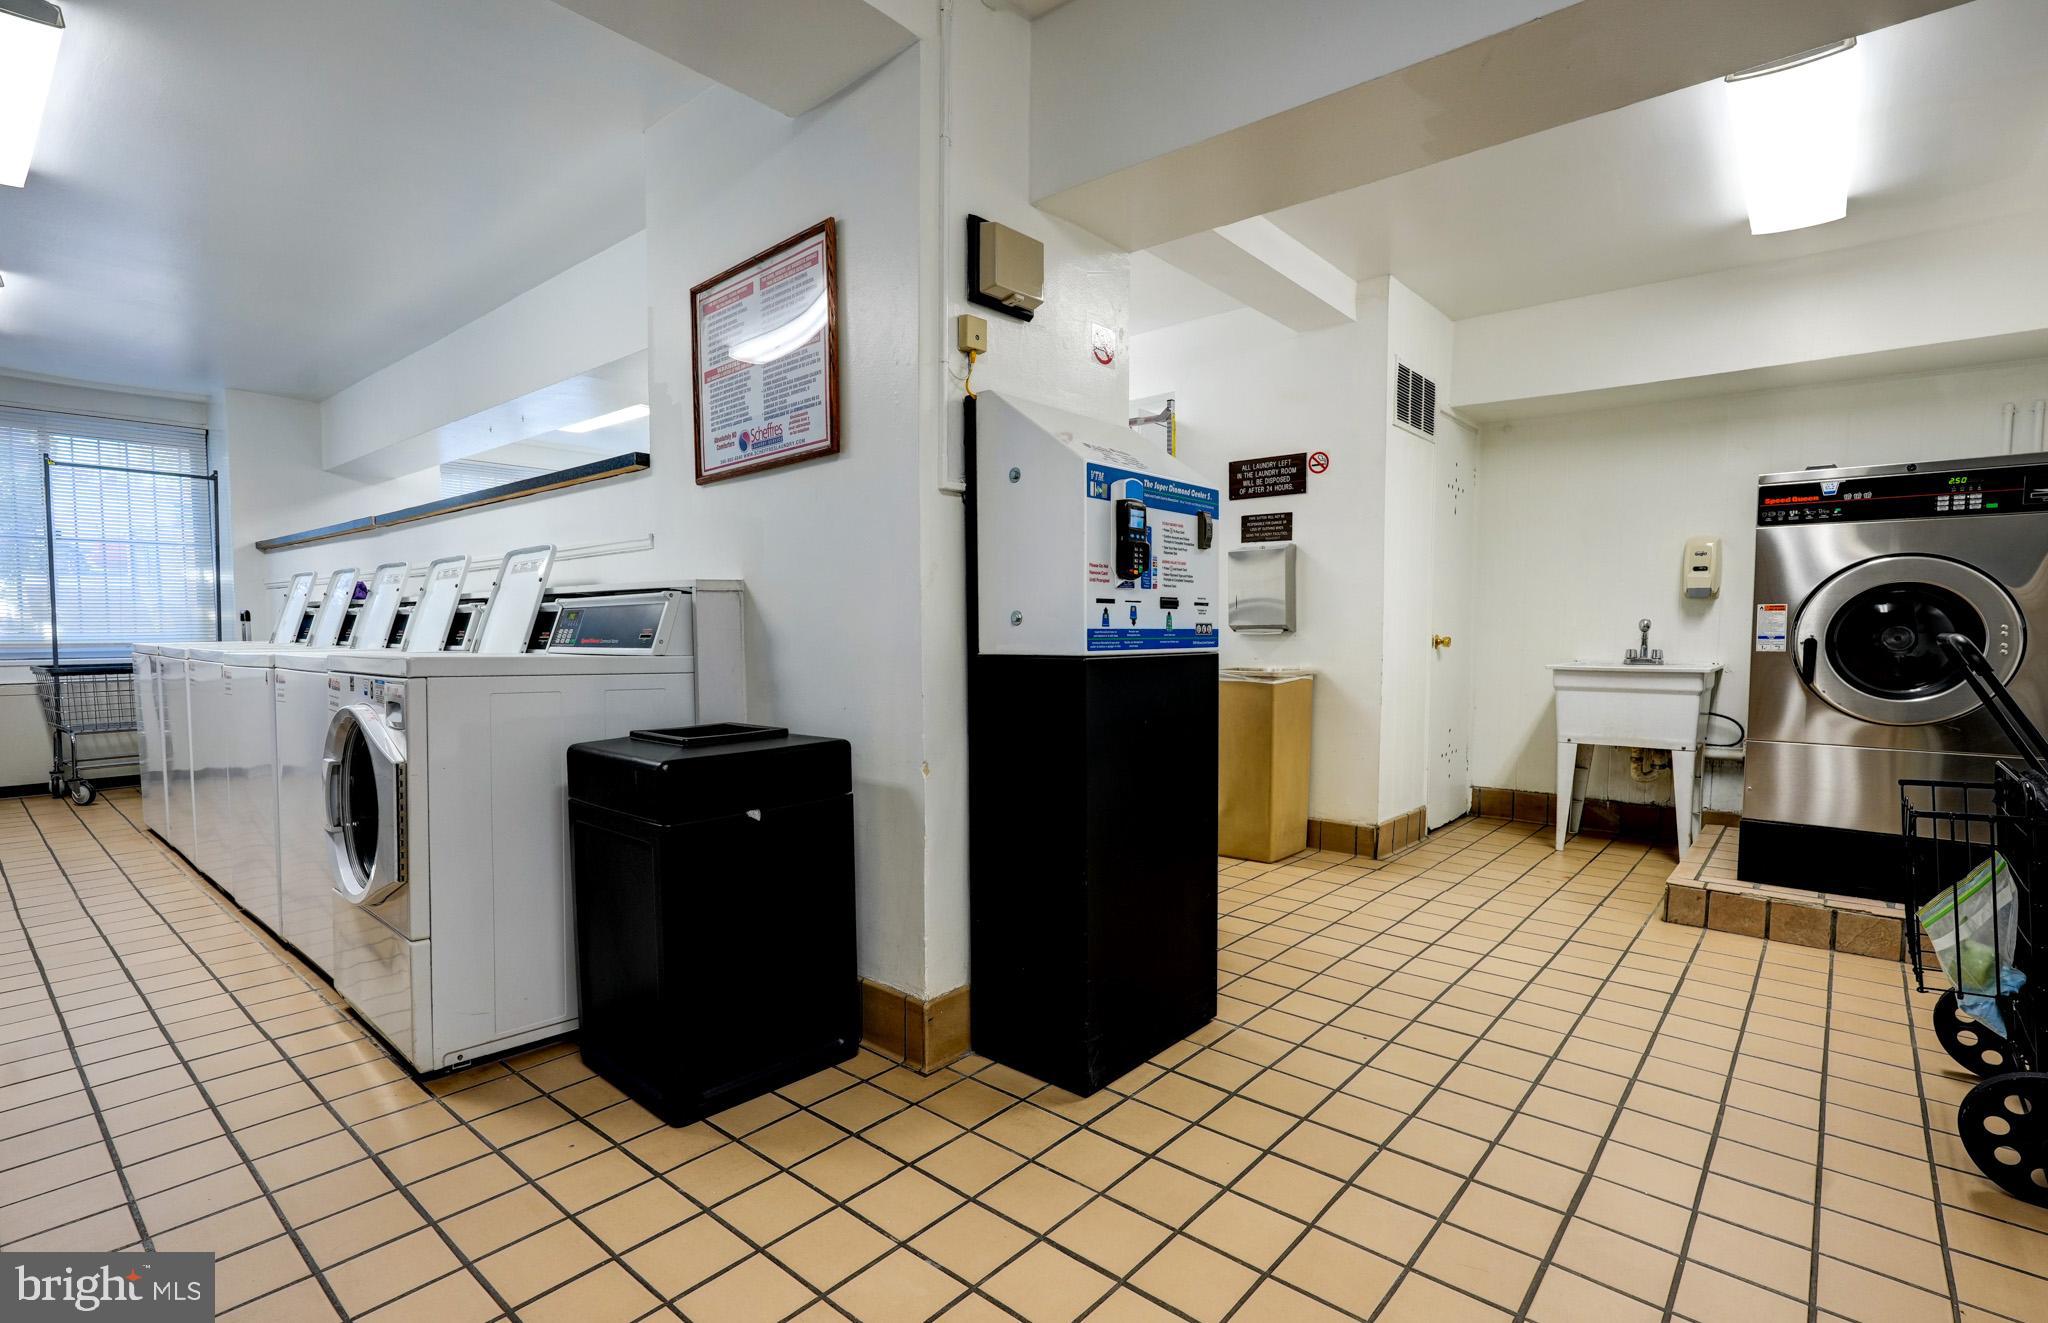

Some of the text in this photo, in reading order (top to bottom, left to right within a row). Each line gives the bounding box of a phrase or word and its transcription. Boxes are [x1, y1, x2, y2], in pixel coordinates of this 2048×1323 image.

[750, 422, 783, 442] Scheffres
[1253, 461, 1276, 470] LAUNDRY
[1278, 459, 1291, 467] LEFT
[1090, 470, 1105, 481] VTM
[1255, 469, 1279, 477] LAUNDRY
[1265, 476, 1290, 484] DISPOSED
[1143, 479, 1153, 489] The
[1154, 481, 1168, 492] Super
[1169, 483, 1190, 496] Diamond
[1274, 483, 1294, 491] HOURS.
[1764, 495, 1820, 505] Speed Queen
